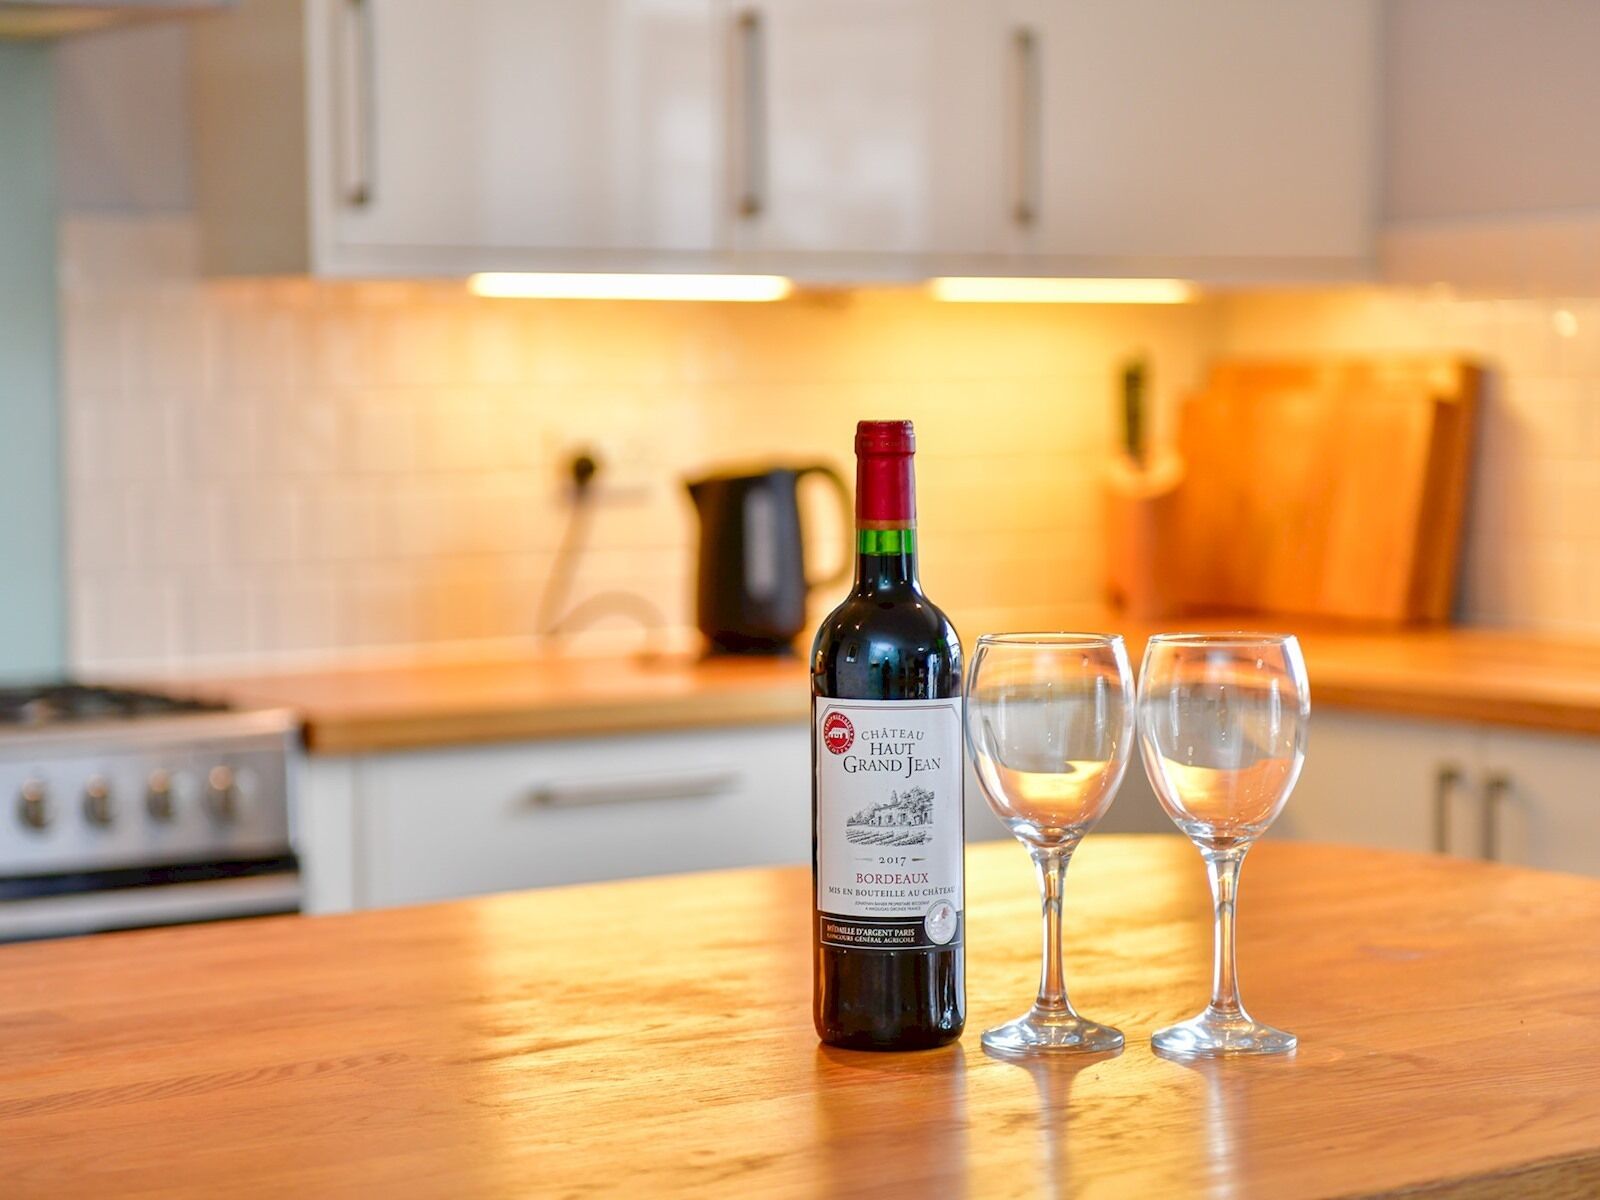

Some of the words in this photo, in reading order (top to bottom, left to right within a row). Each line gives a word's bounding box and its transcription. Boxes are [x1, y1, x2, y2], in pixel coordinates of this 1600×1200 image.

[861, 727, 925, 741] CHÂTEAU
[870, 742, 915, 755] HAUT
[843, 755, 902, 773] GRAND
[905, 756, 941, 779] JEAN
[879, 857, 907, 867] 2017
[856, 872, 929, 885] BORDEAUX
[828, 886, 841, 895] MIS
[842, 888, 853, 896] EN
[855, 889, 906, 898] BOUTEILLE
[908, 889, 920, 897] AU
[922, 886, 956, 896] CHÂTEAU
[894, 928, 915, 937] PARIS
